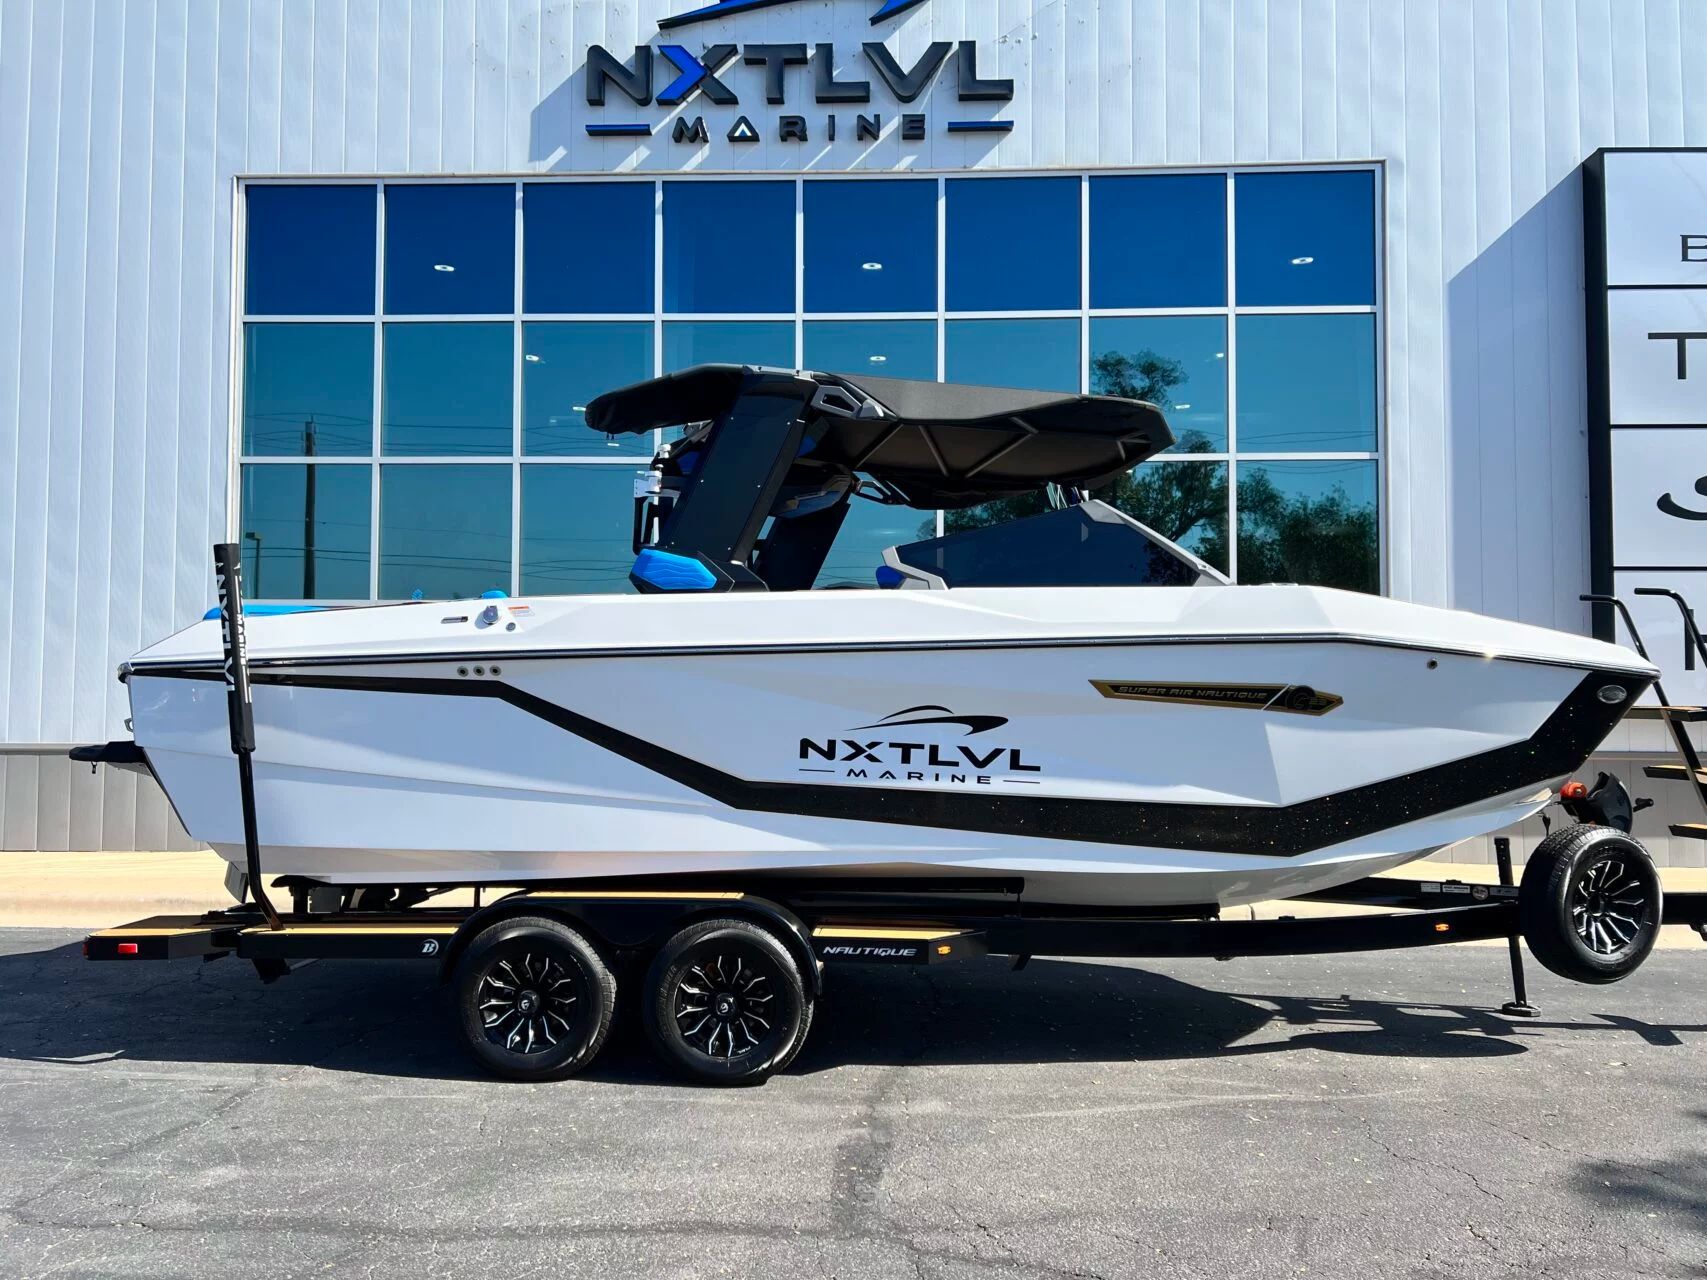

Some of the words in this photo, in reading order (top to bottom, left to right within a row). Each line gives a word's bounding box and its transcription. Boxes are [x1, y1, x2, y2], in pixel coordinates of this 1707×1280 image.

[586, 40, 1014, 105] NXTLVL
[672, 113, 926, 144] MARINE
[1118, 686, 1167, 694] SUPER
[1169, 688, 1194, 696] AIR
[1196, 689, 1268, 699] NAUTIQUE
[799, 737, 1041, 772] NXTLVL
[846, 768, 992, 785] MARINE
[822, 946, 918, 957] NAUTIQUE
